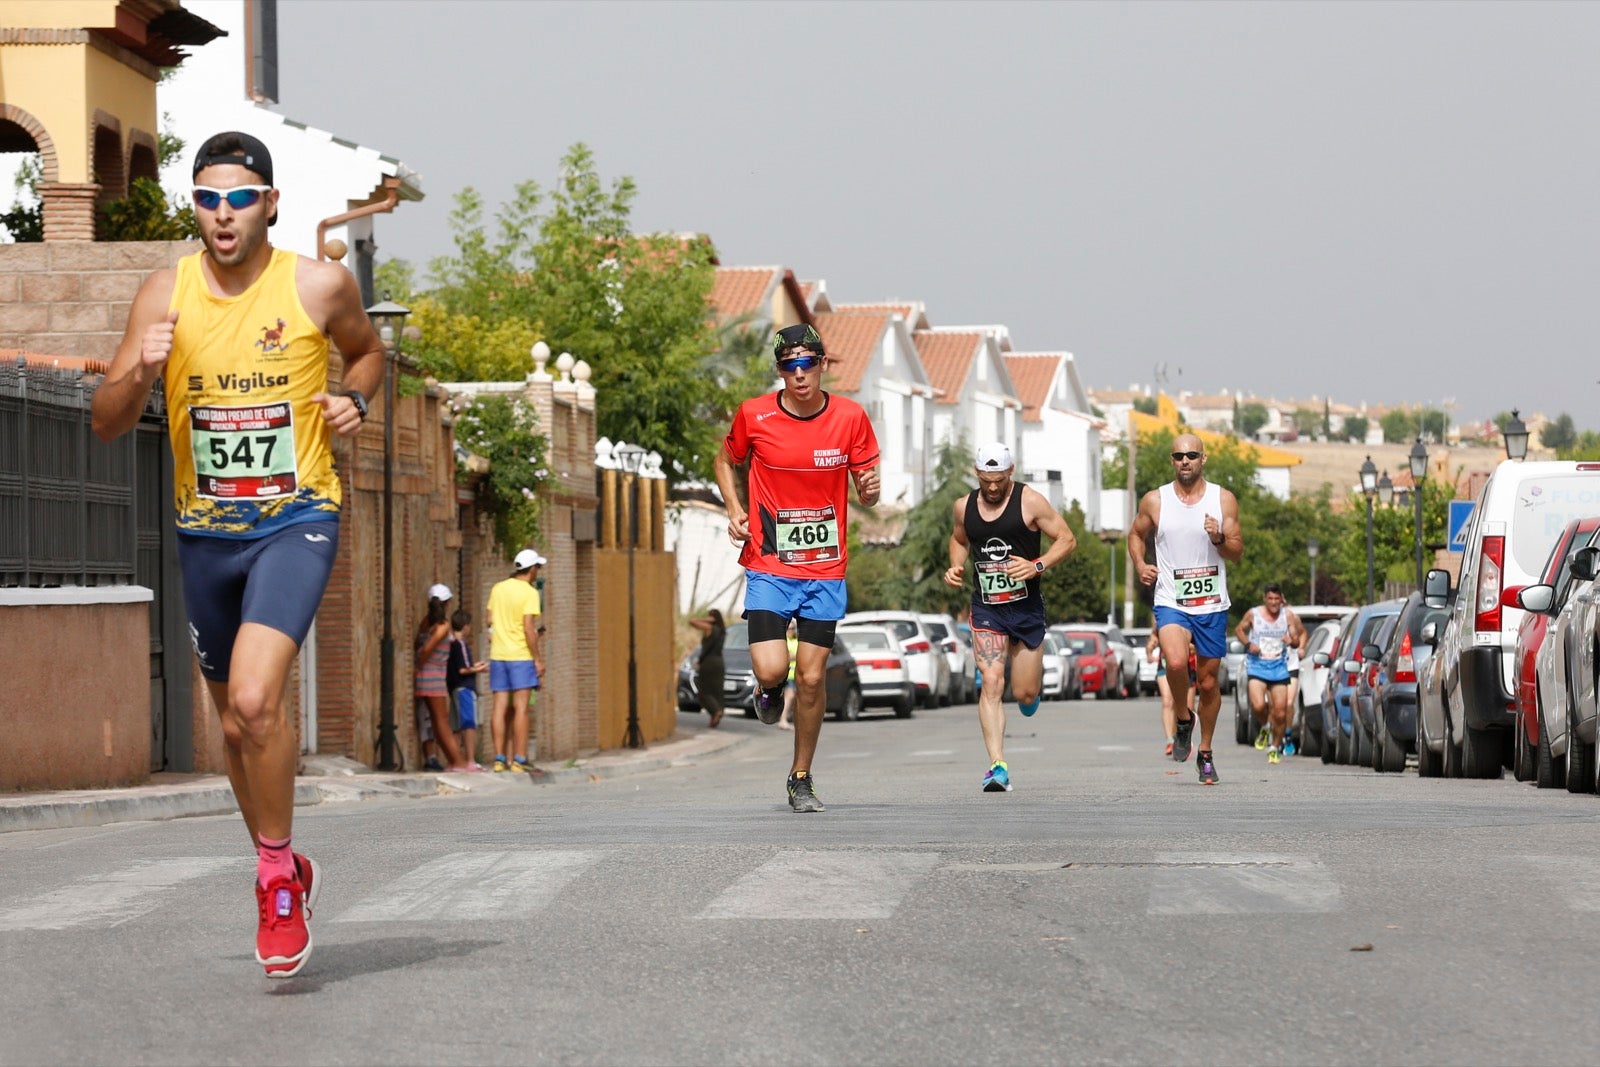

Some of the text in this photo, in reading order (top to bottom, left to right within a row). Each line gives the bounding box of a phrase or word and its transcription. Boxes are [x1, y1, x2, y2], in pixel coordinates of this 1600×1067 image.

[217, 372, 289, 393] Vigilsa
[209, 435, 277, 470] 547
[813, 448, 840, 457] RUNNING
[788, 524, 829, 545] 460
[1182, 578, 1213, 596] 295
